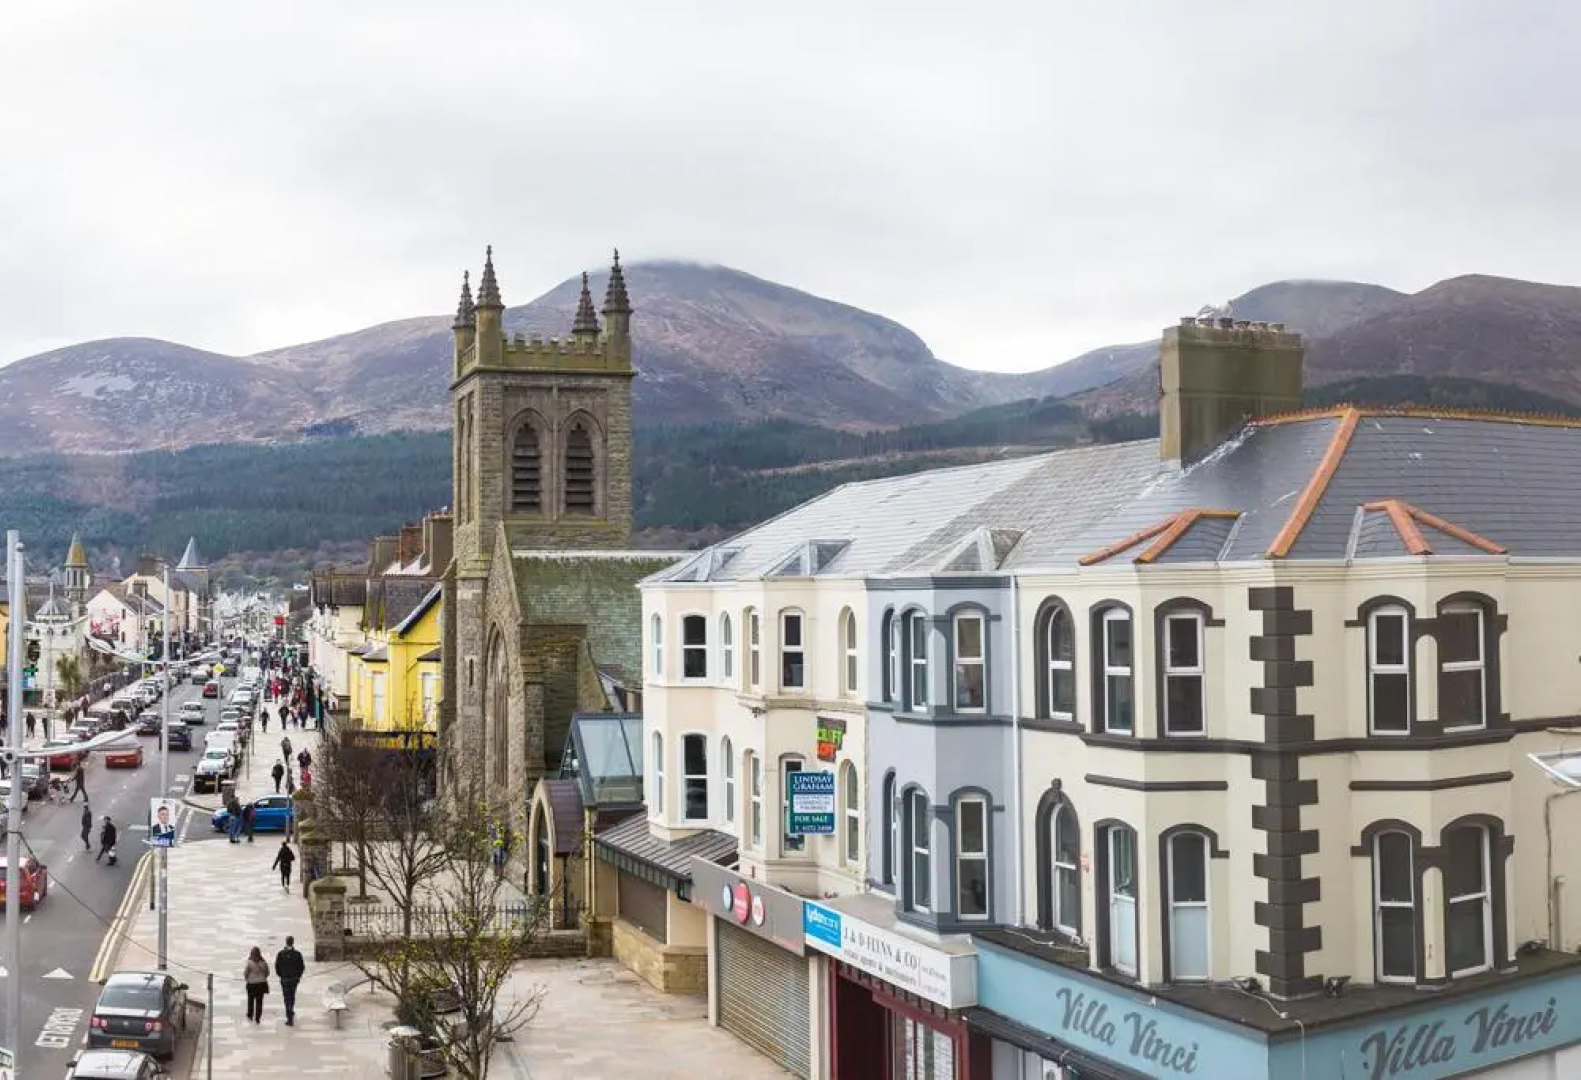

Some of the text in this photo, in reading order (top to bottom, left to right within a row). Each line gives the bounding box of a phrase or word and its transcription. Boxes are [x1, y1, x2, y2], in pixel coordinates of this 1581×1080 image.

[795, 815, 809, 823] FOR
[895, 948, 902, 964] &
[1056, 987, 1199, 1074] Villa Vinci
[1360, 997, 1559, 1080] Villa Vinci
